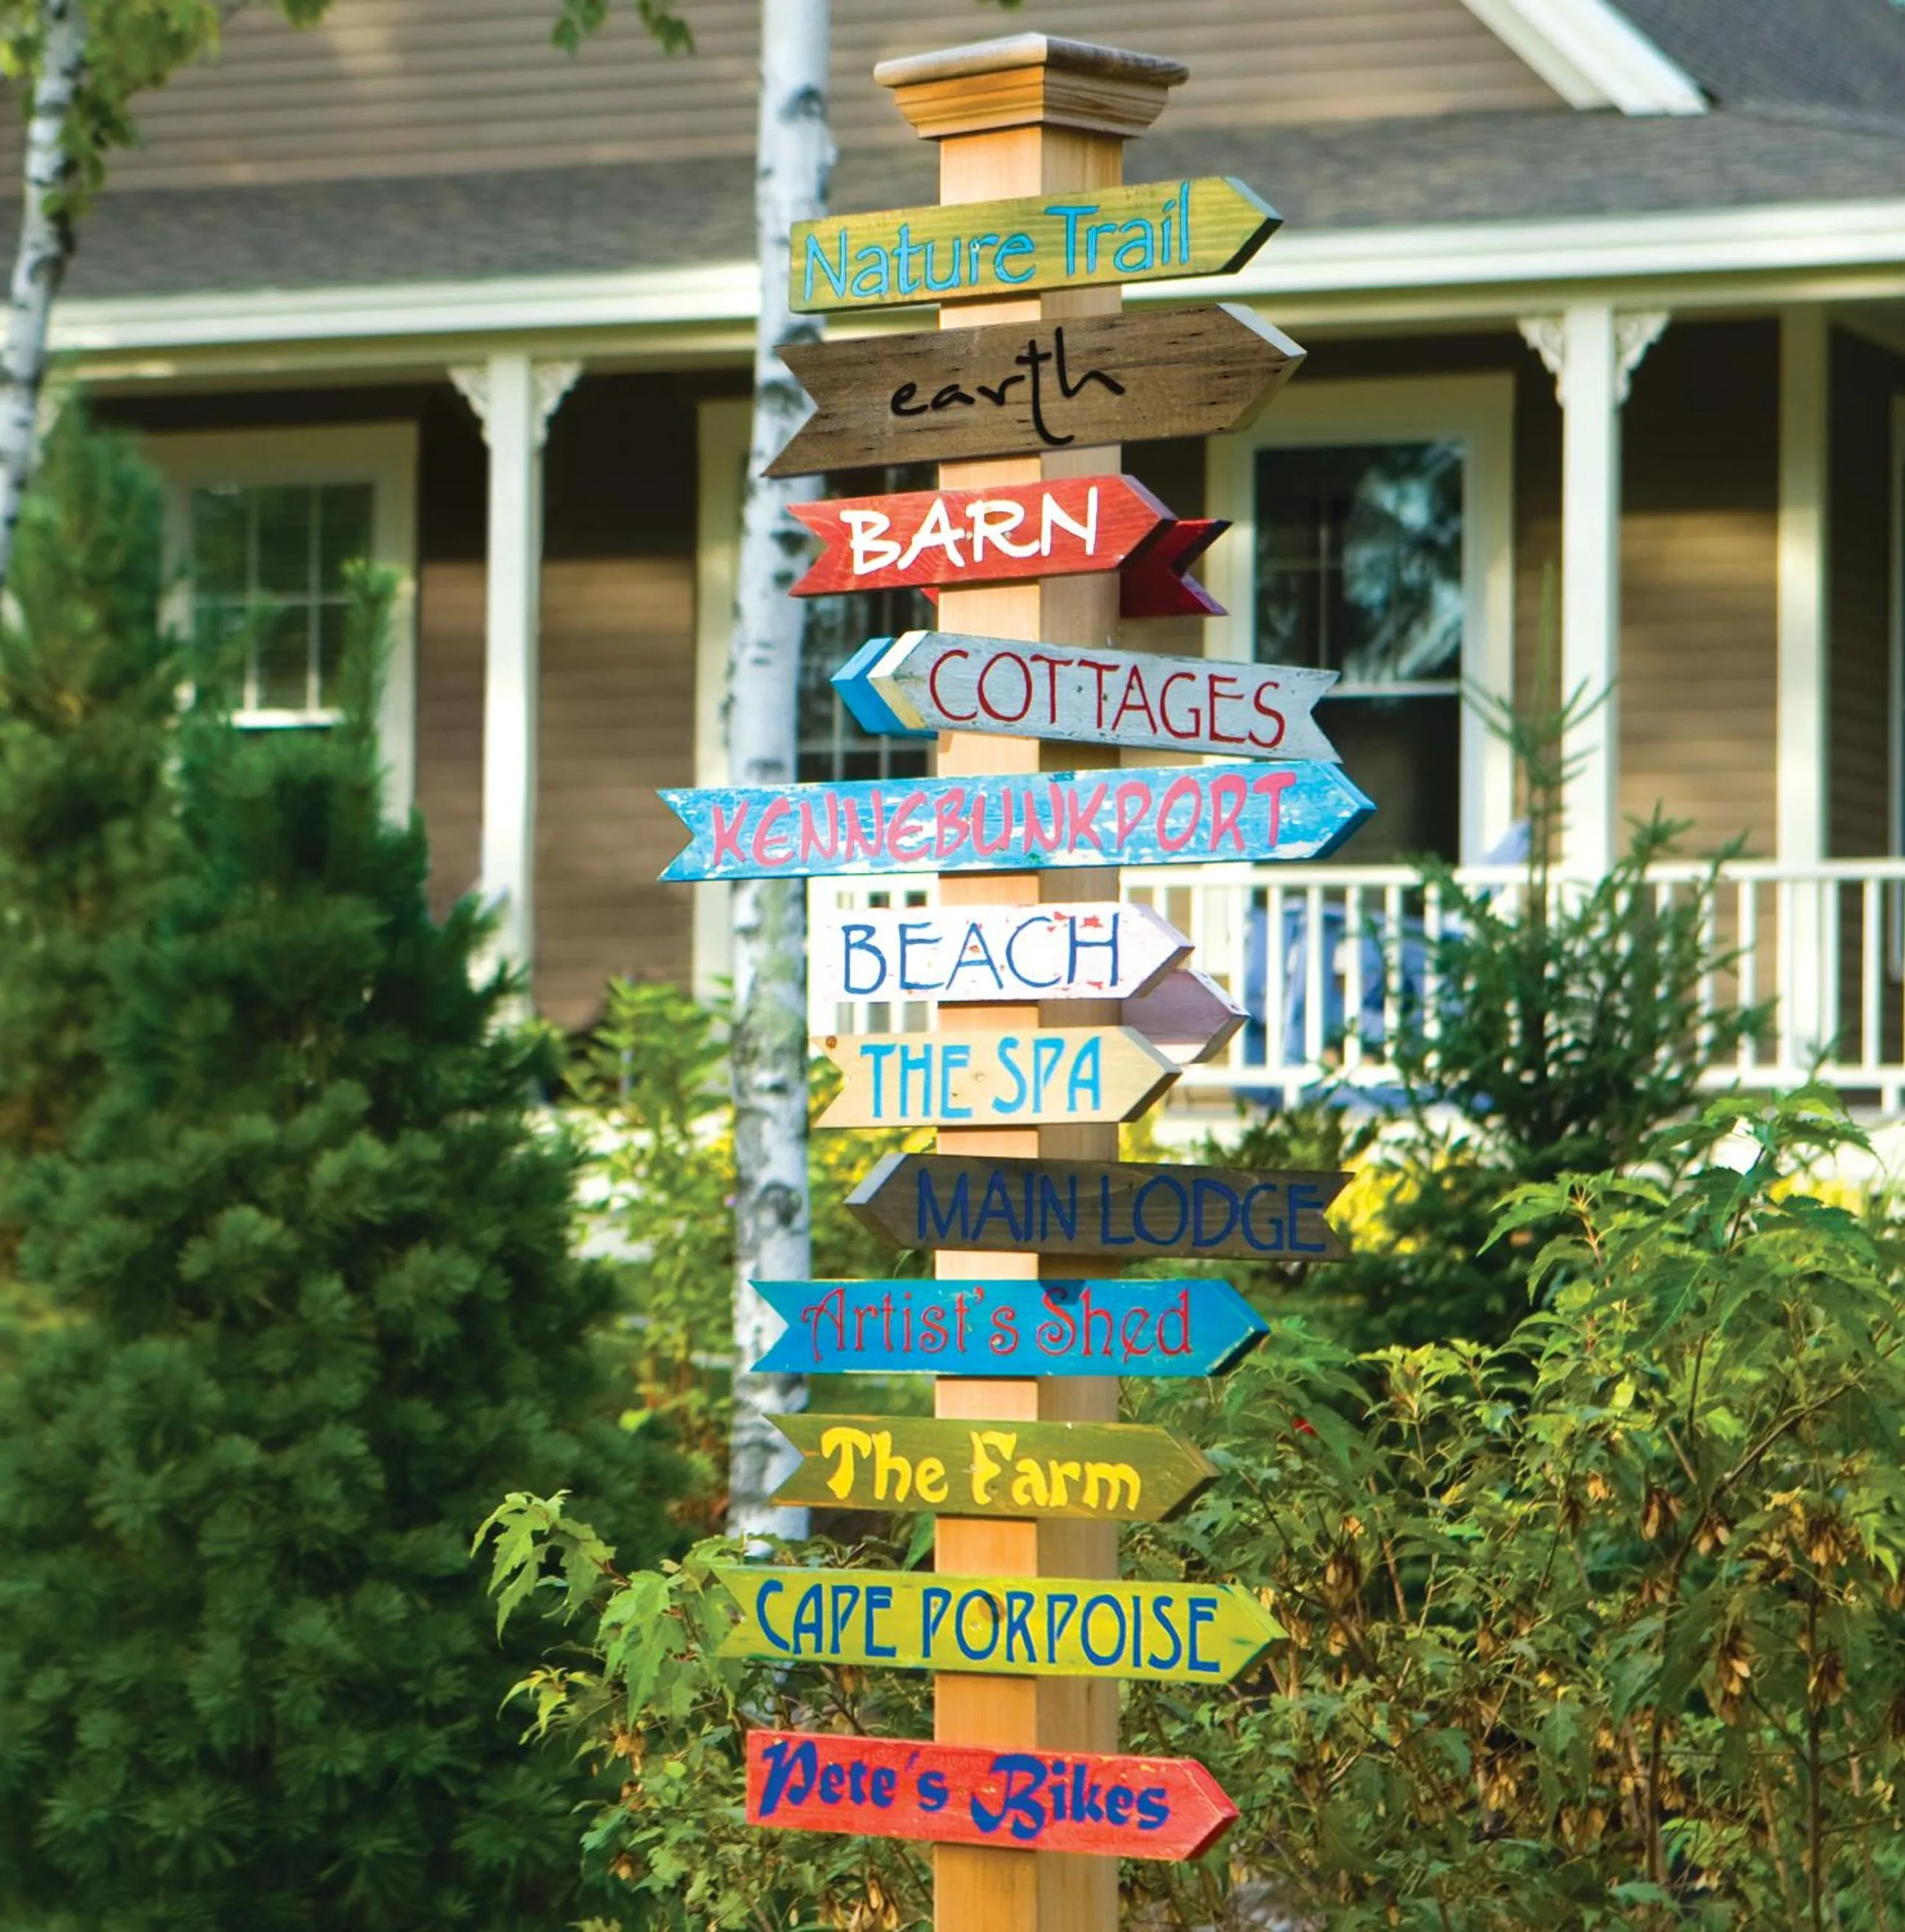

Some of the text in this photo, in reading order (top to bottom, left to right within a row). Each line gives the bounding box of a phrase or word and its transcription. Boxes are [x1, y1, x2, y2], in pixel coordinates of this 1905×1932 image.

[804, 179, 1191, 302] Nature Trail
[891, 326, 1125, 445] earth
[839, 486, 1099, 576] BARN
[928, 649, 1285, 749] COTTAGES
[712, 771, 1298, 868] KENNEBUNKPORT
[841, 912, 1121, 995] BEACH
[860, 1035, 1102, 1119] THE SPA
[916, 1169, 1326, 1253] MAIN LODGE
[802, 1285, 1193, 1364] Artist's Shed
[820, 1426, 1141, 1512] The Farm
[756, 1579, 1220, 1673] CAPE PORPOISE
[758, 1739, 1170, 1840] Pete's Bikes
